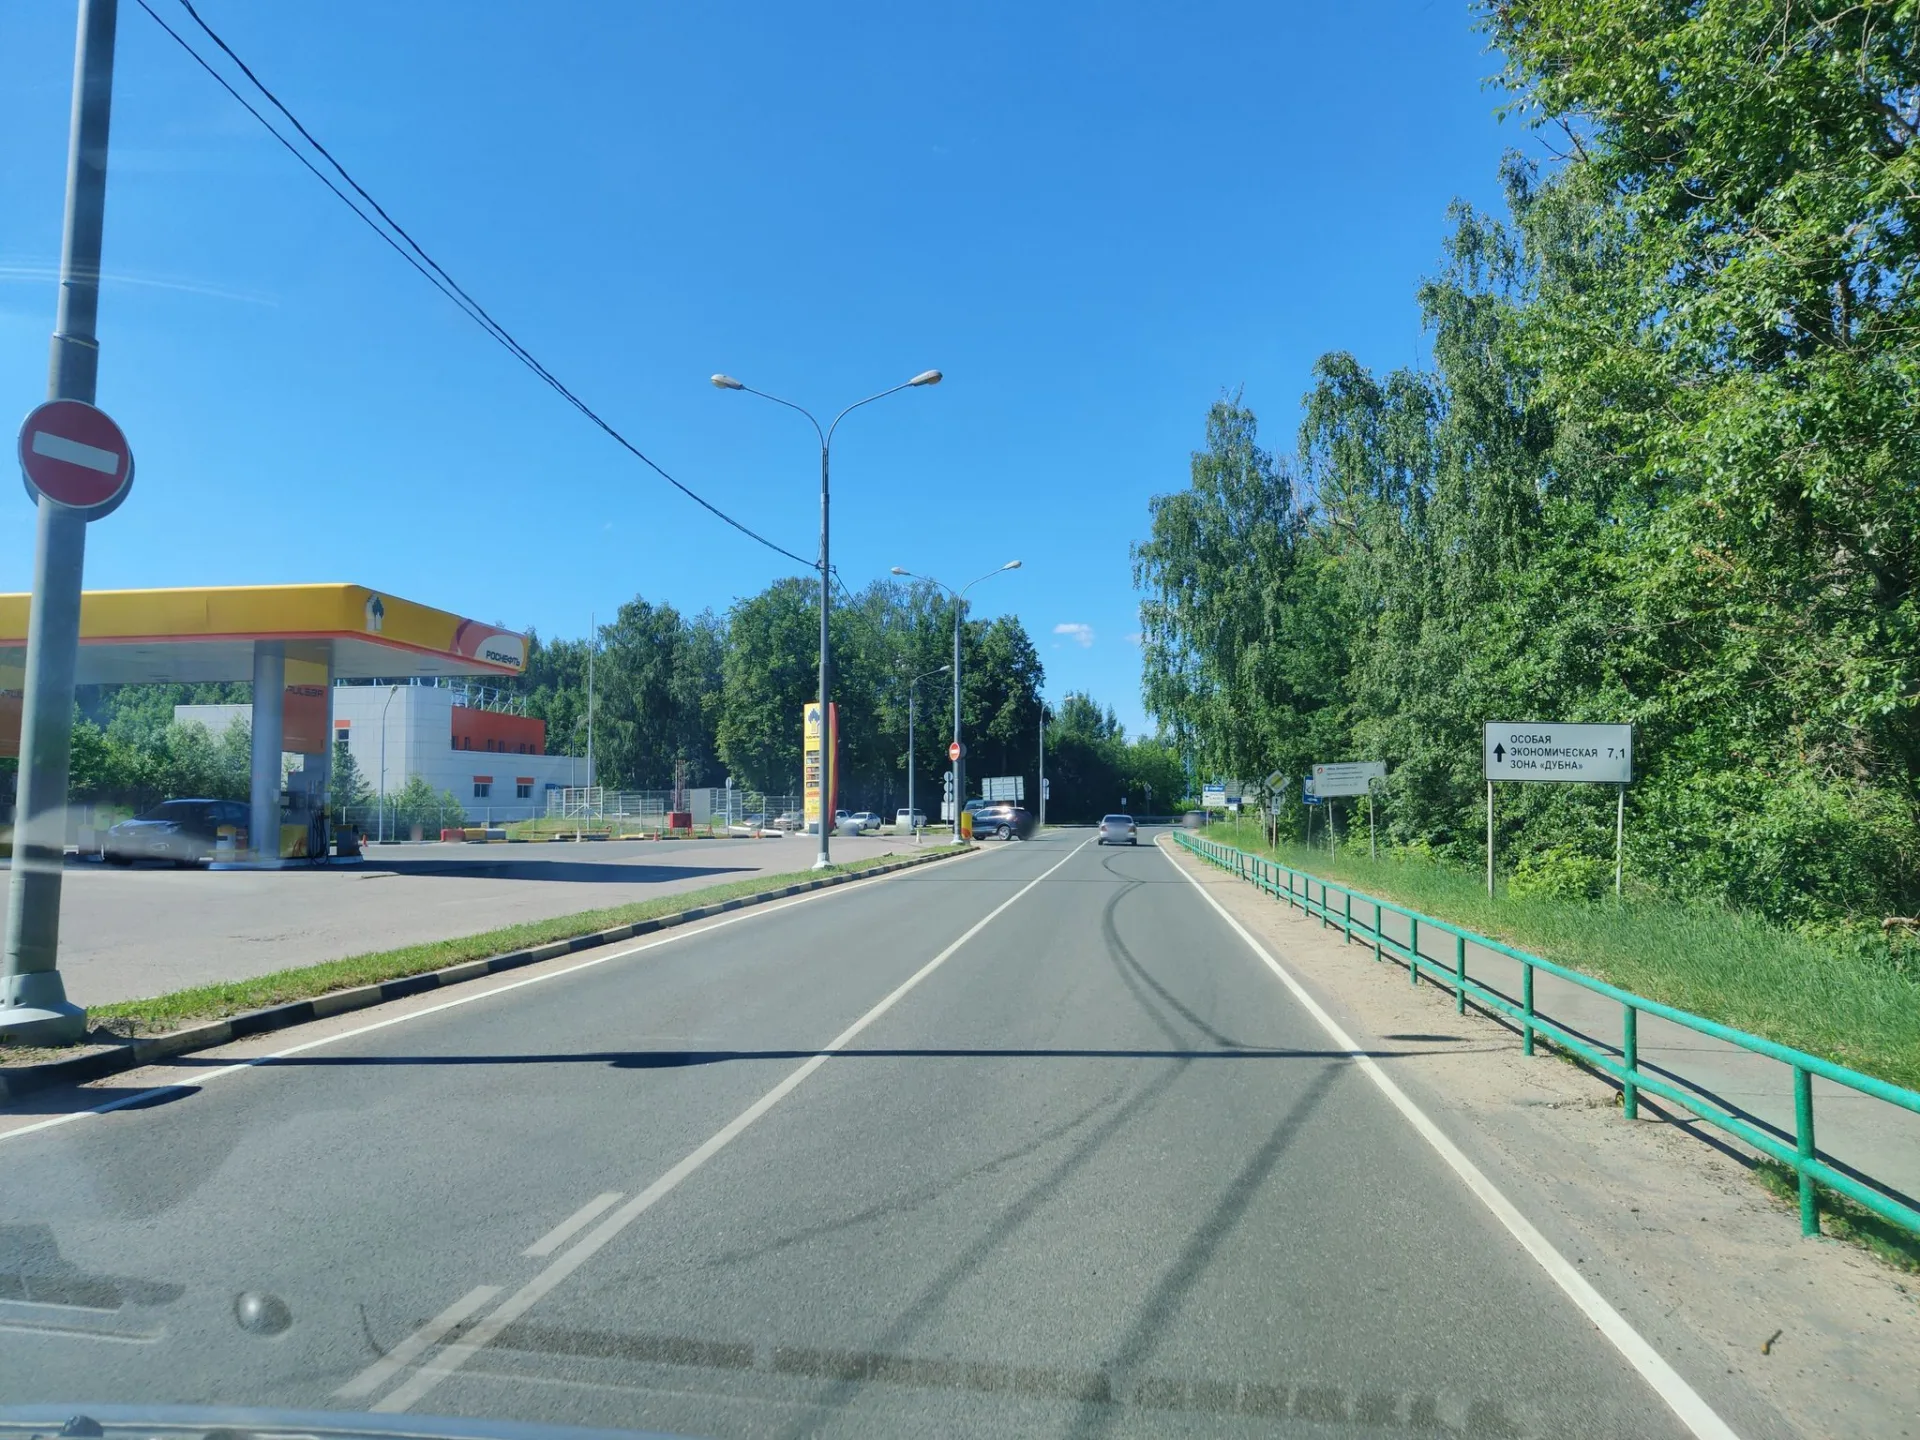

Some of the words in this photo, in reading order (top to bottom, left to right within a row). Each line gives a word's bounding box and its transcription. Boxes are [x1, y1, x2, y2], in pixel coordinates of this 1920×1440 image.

[486, 650, 520, 666] РОСНЕФТЬ
[1510, 734, 1552, 744] ОСОБАЯ
[1510, 747, 1598, 758] ЭКОНОМИЧЕСКАЯ
[1607, 748, 1625, 760] 7,1
[1510, 760, 1537, 769] ЗОНА
[1540, 761, 1583, 771] «ДУБНА»
